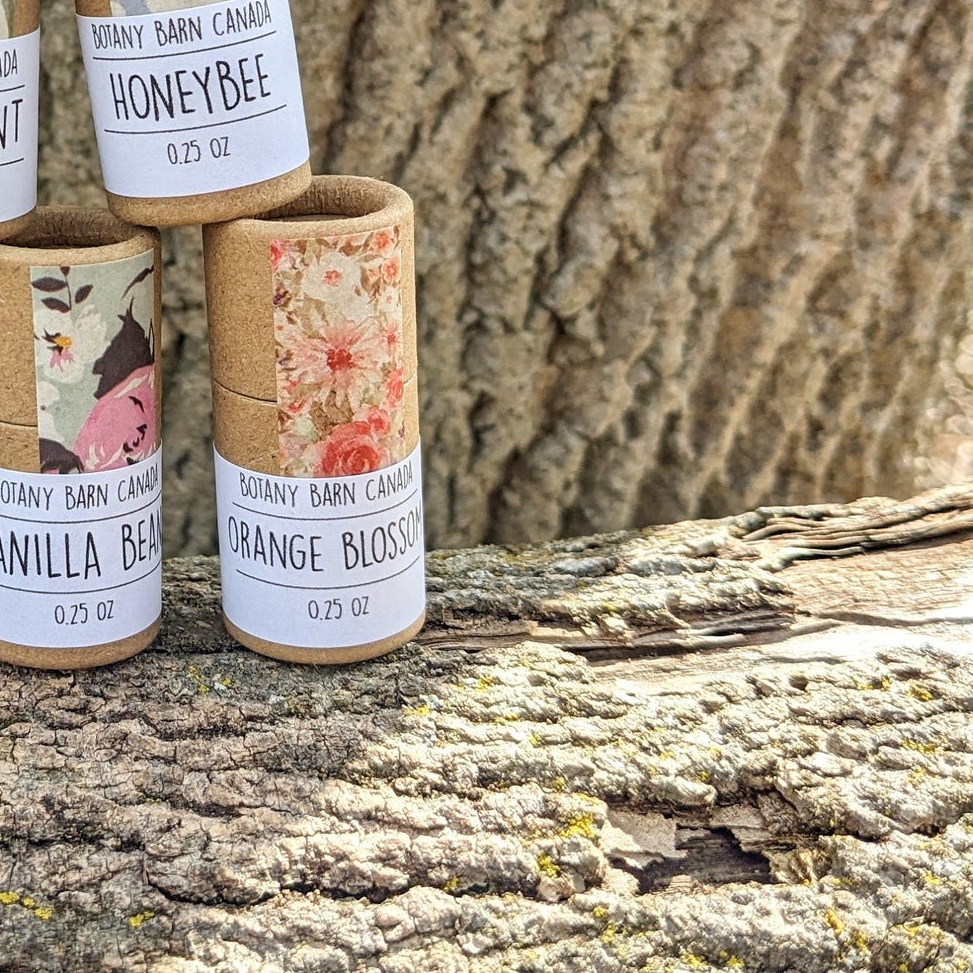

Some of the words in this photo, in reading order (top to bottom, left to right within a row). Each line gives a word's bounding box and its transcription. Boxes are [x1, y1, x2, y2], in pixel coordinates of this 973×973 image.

[91, 23, 143, 49] BOTANY
[154, 16, 202, 46] BARN
[109, 54, 271, 121] HONEYBEE
[168, 140, 201, 164] 0.25
[210, 136, 230, 158] OZ
[66, 484, 108, 510] BARN
[118, 462, 158, 502] CANADA
[240, 472, 298, 507] BOTANY
[310, 482, 355, 508] BARN
[366, 462, 412, 501] CANADA
[228, 516, 324, 572] ORANGE
[54, 603, 88, 625] 0.25
[97, 600, 114, 621] OZ
[308, 598, 342, 620] 0.25
[351, 596, 369, 617] OZ
